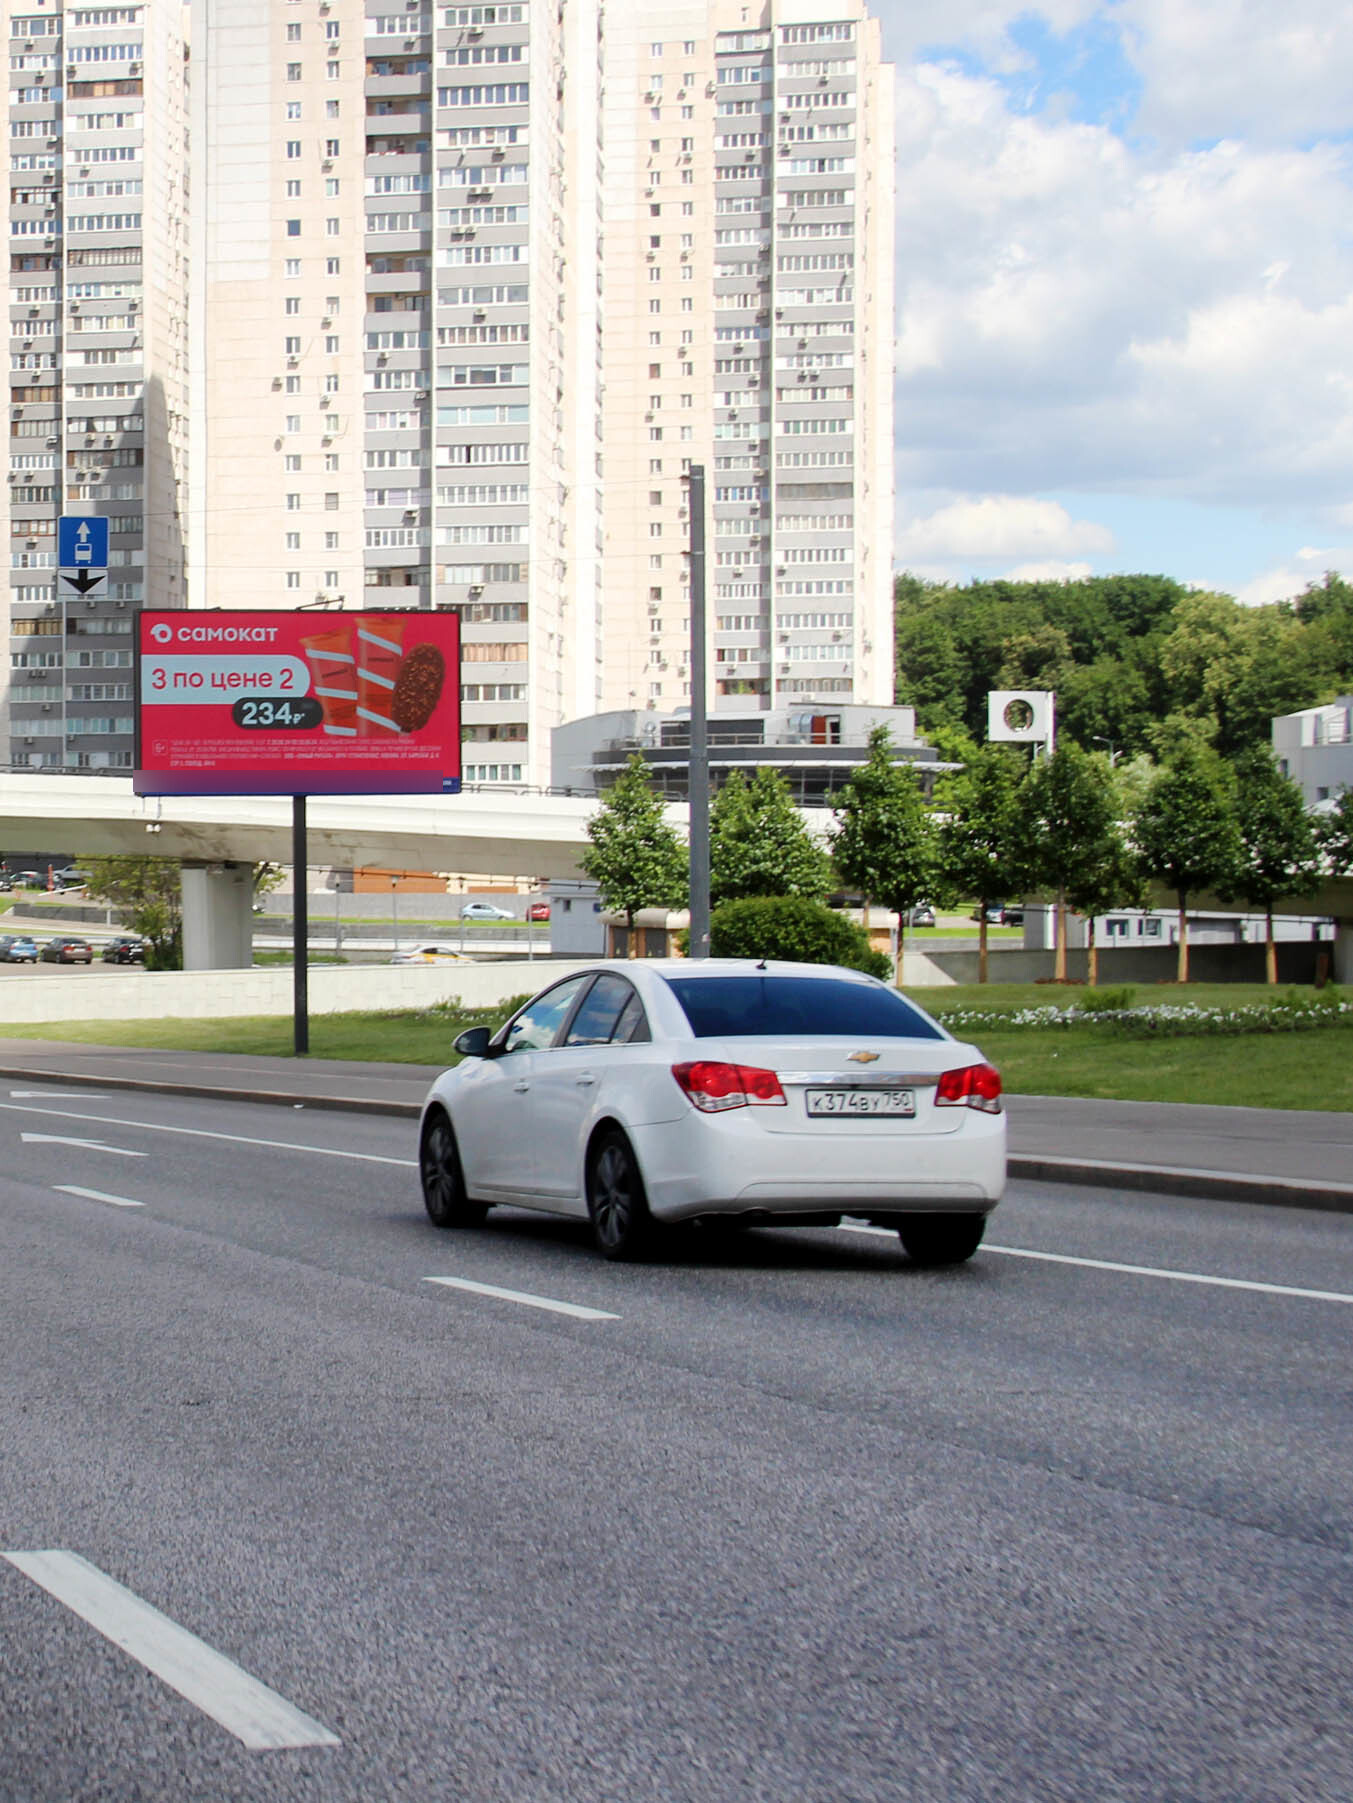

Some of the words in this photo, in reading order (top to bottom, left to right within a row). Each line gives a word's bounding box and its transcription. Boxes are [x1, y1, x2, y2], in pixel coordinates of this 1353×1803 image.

[177, 626, 279, 642] самокат
[151, 668, 167, 690] 3
[173, 672, 204, 688] по
[211, 672, 273, 691] цене
[279, 668, 294, 690] 2
